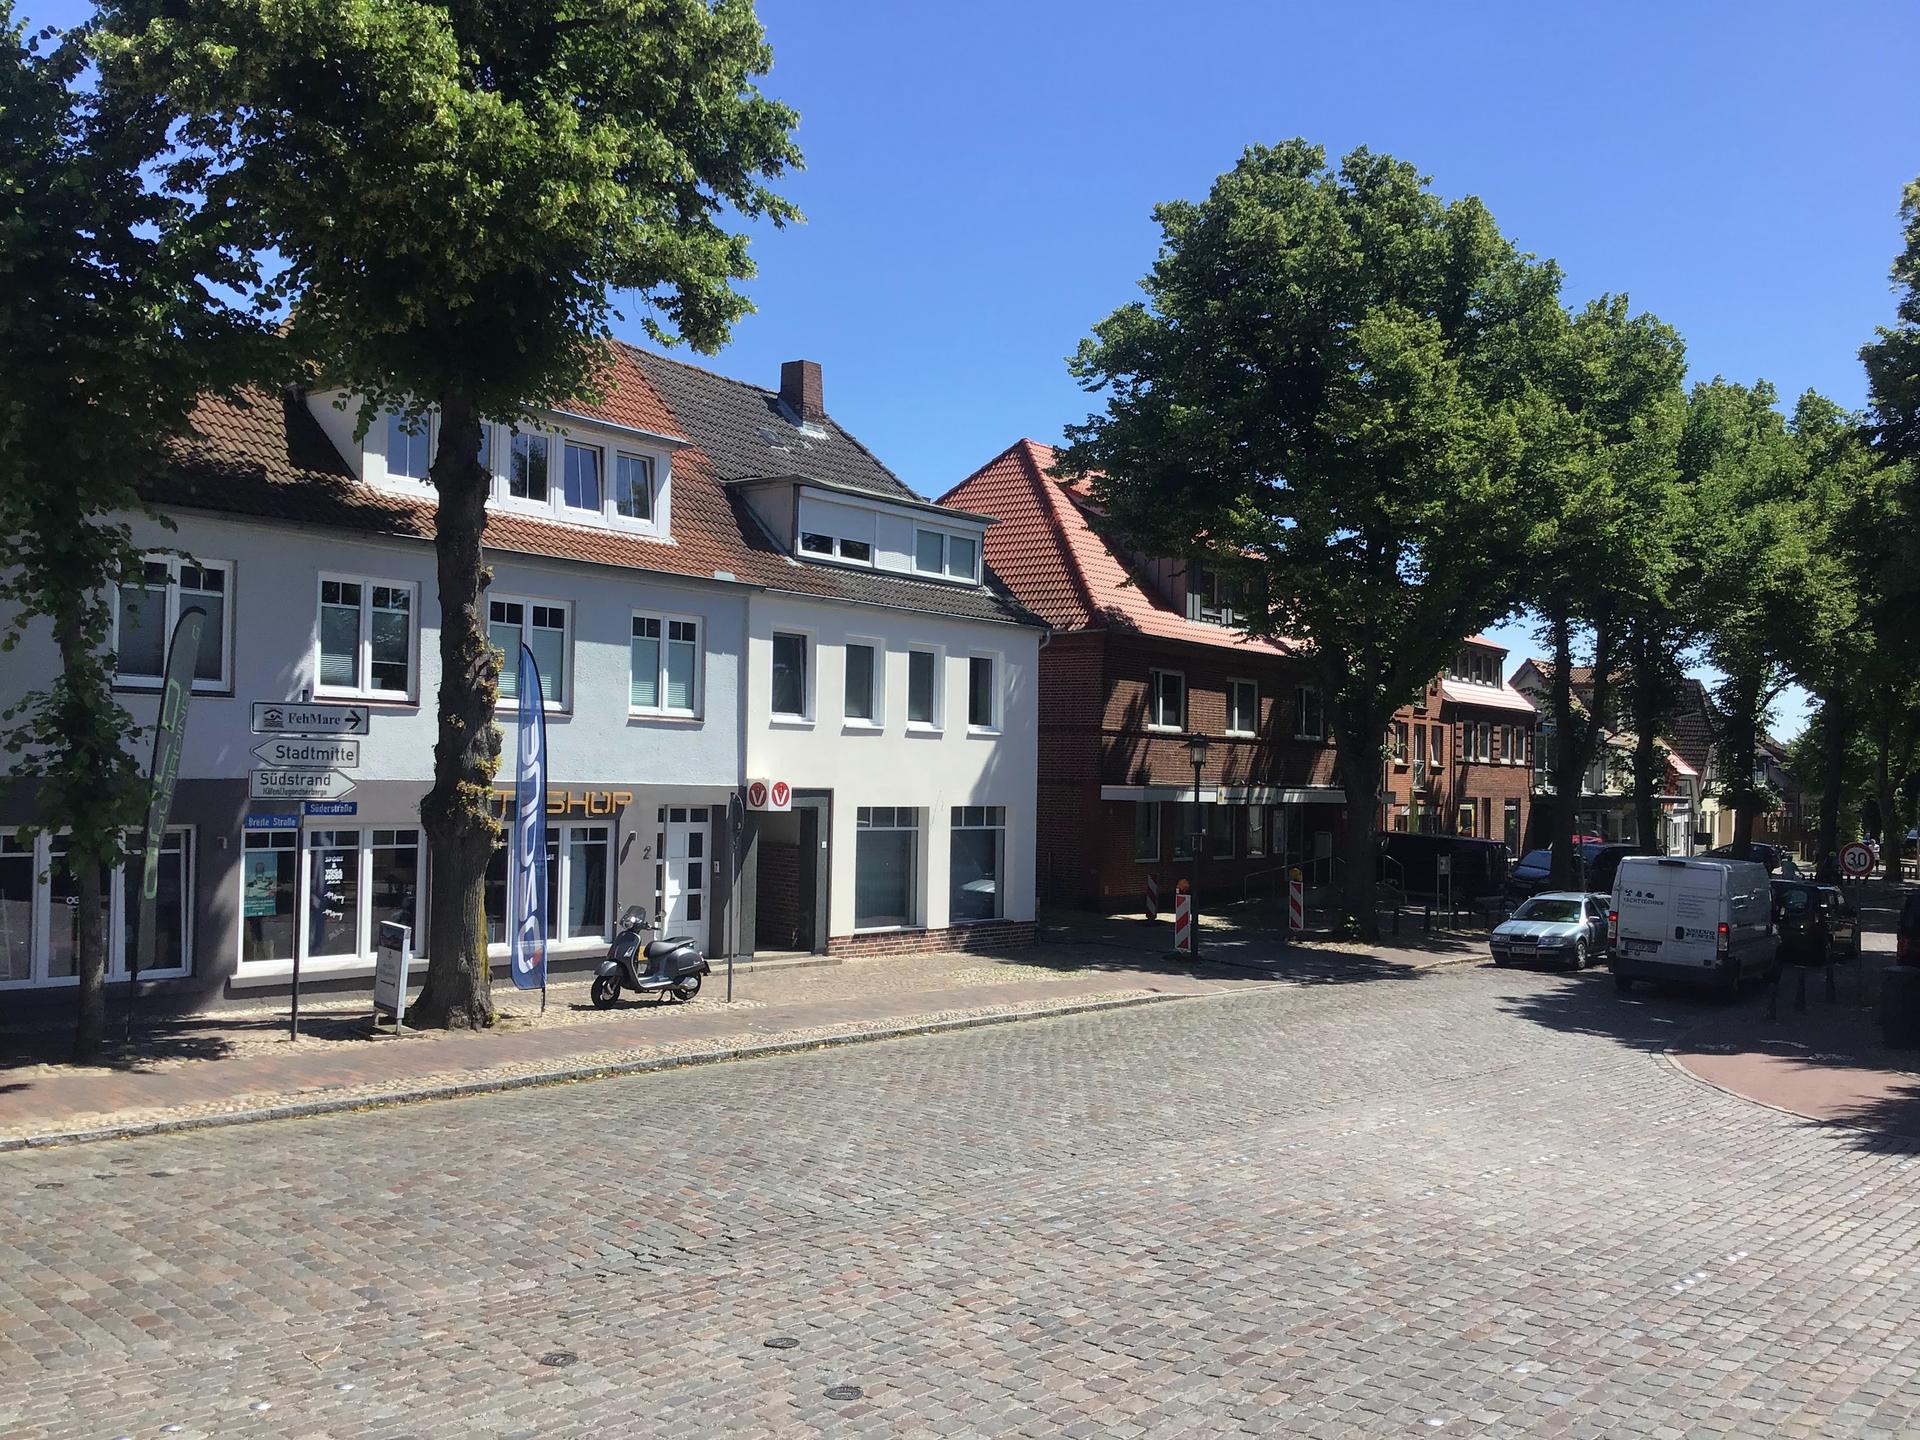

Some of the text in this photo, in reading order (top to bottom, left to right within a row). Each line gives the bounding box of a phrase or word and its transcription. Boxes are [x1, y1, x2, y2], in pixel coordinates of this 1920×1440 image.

[288, 712, 341, 725] FehMare
[275, 745, 354, 761] Stadtmitte
[260, 772, 331, 786] Südstrand
[310, 803, 353, 813] Süderstraße
[546, 791, 633, 815] SHOP
[248, 817, 296, 827] Breite Straße
[643, 845, 652, 860] 2
[1847, 852, 1867, 867] 30
